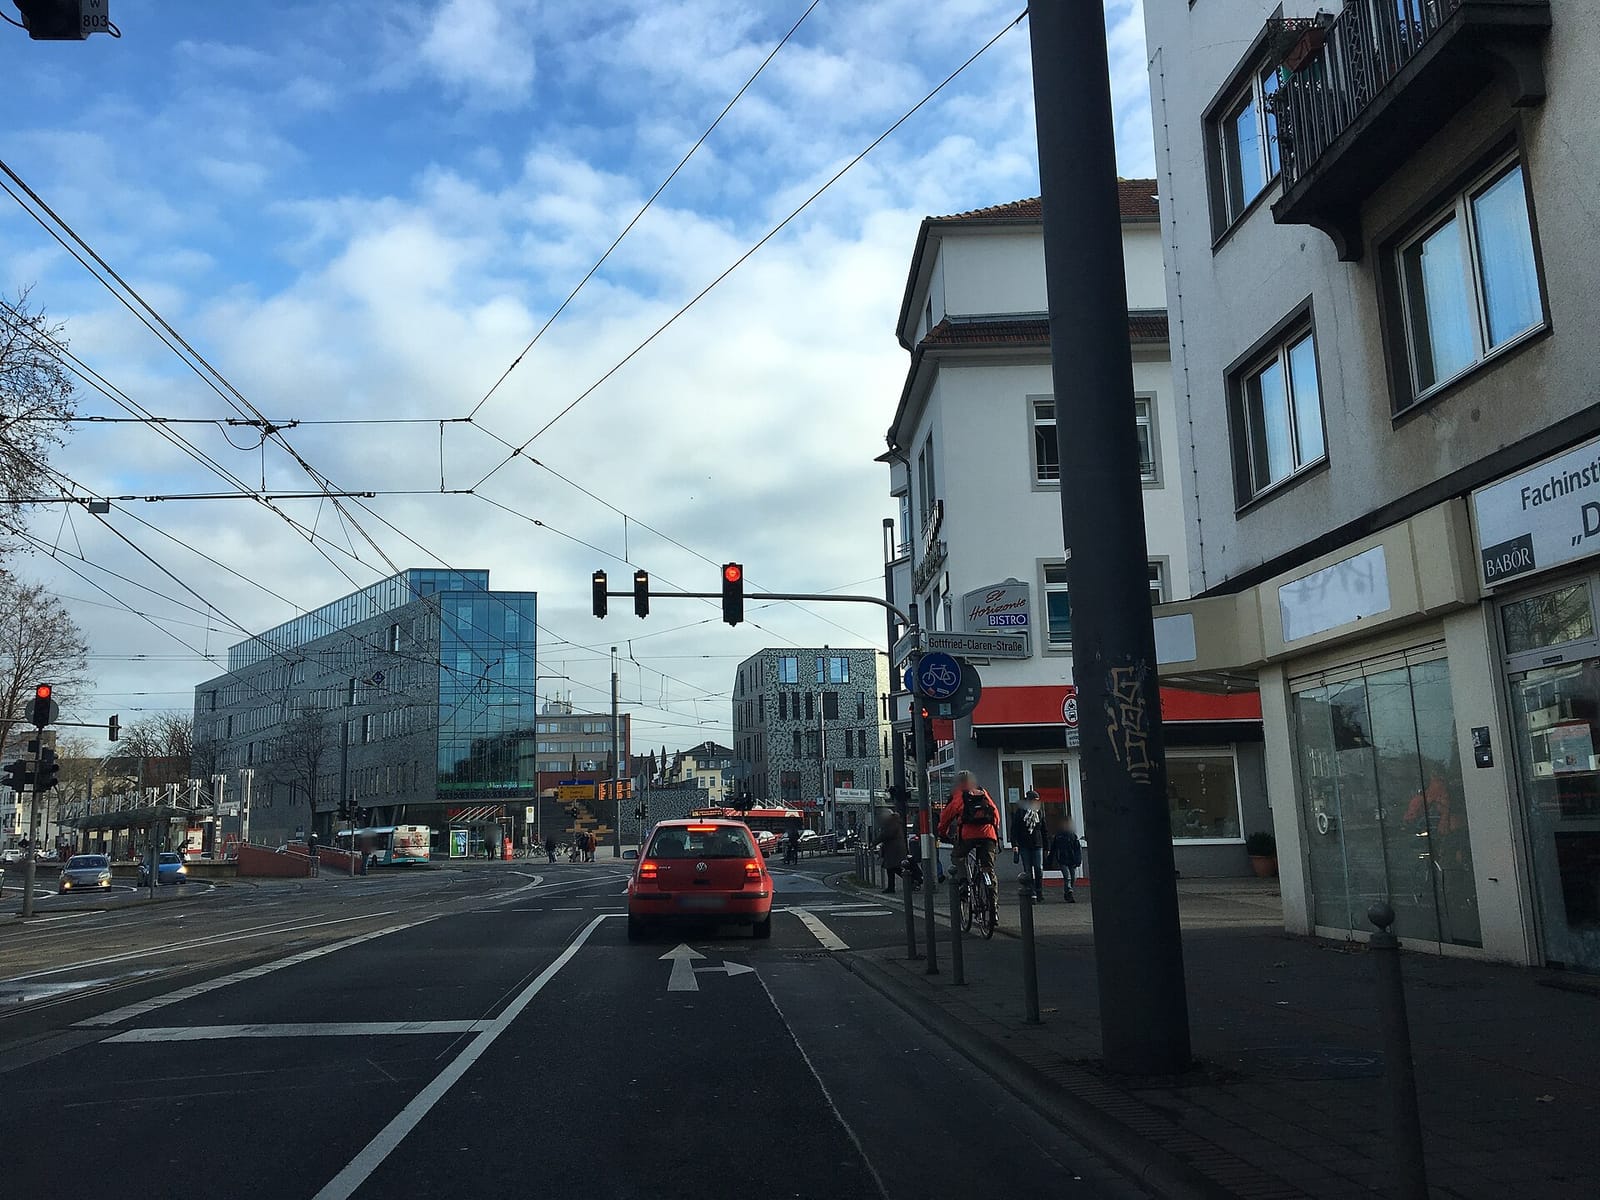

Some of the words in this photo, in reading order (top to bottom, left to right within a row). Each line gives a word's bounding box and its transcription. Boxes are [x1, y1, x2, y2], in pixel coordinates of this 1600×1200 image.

[83, 15, 108, 27] 803
[985, 589, 1006, 604] El
[969, 598, 1027, 622] Horizonte
[989, 614, 1026, 625] BISTRO
[928, 636, 1023, 652] Gottfried-Claren-Straße
